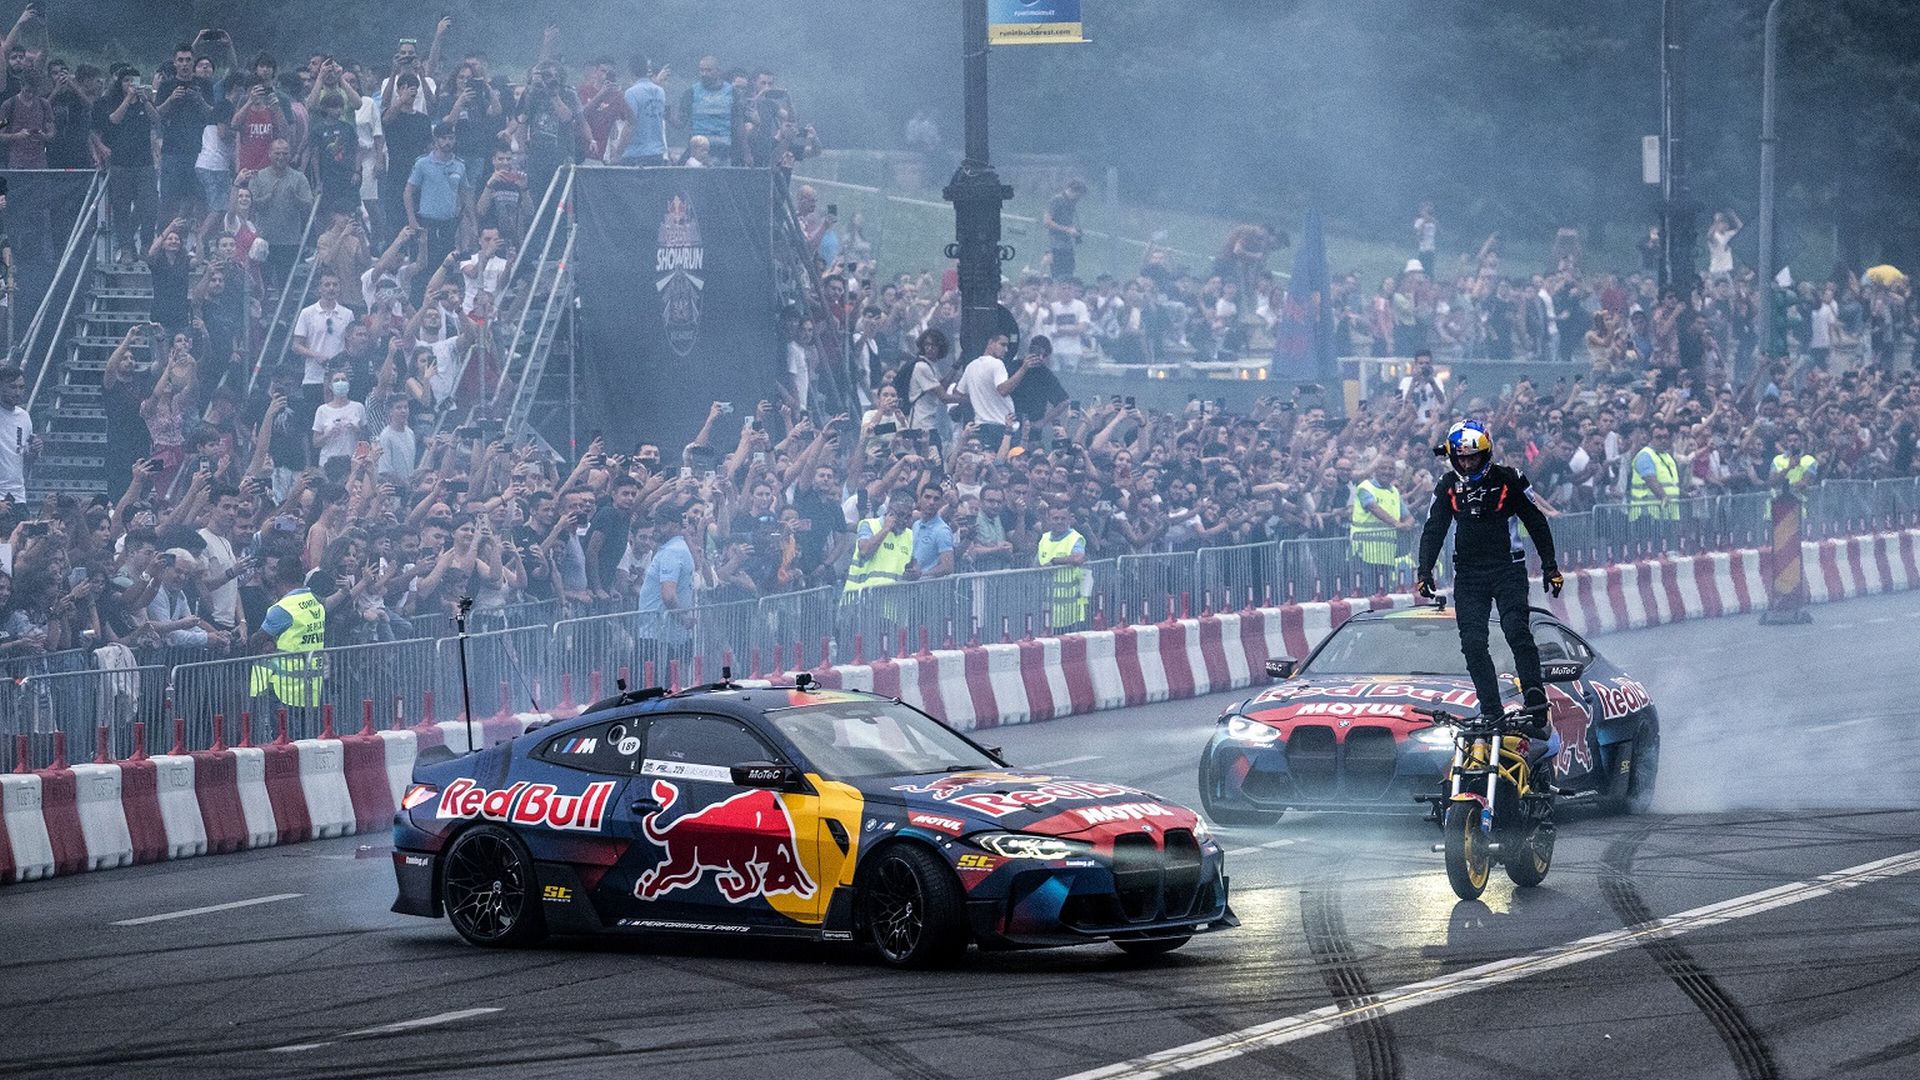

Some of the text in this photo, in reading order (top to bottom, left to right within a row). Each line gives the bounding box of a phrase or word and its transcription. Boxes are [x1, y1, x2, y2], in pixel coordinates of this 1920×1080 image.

[656, 247, 704, 272] SHOWRUN
[1551, 666, 1577, 675] MoTeC
[1252, 683, 1480, 708] Red Bull
[1588, 680, 1639, 720] Red
[1295, 703, 1406, 716] MOTUL
[621, 741, 636, 751] 189
[748, 769, 780, 779] MoTeC
[437, 778, 616, 831] Red Bull
[948, 782, 1094, 817] Red
[912, 815, 962, 831] MOTUL
[1077, 802, 1174, 825] MOTUL
[639, 920, 716, 931] PERFORMANCE
[714, 924, 750, 932] PARTS
